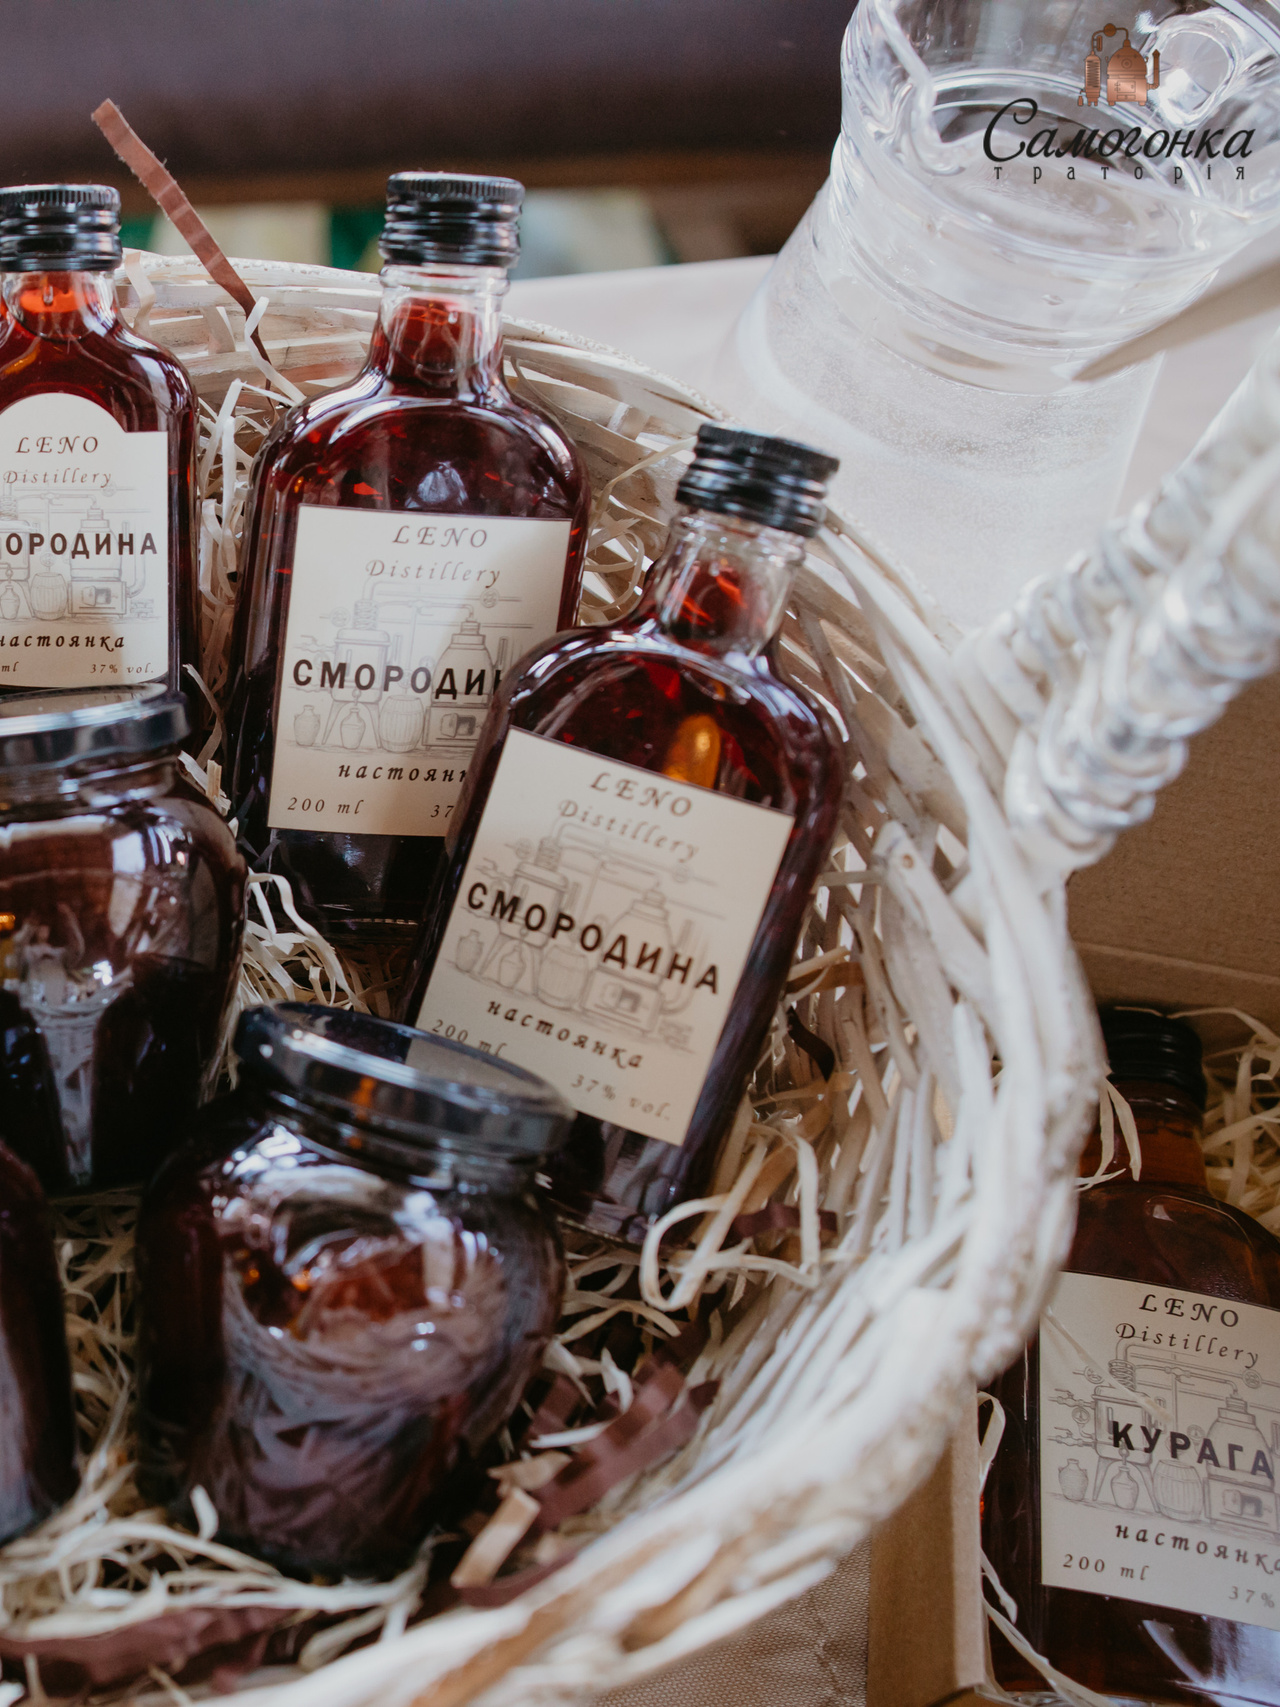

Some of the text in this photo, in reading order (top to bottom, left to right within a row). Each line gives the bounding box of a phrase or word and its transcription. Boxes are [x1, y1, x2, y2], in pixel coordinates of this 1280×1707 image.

[16, 436, 99, 454] LENO
[3, 468, 112, 488] Distillery
[392, 525, 488, 548] LENO
[366, 559, 500, 588] Distillery
[1, 660, 20, 673] ml
[90, 663, 118, 674] 37%
[127, 661, 154, 674] vol.
[293, 658, 503, 700] СМОРОДИ
[338, 763, 467, 783] настоян
[287, 797, 454, 819] 200 ml 37
[590, 772, 692, 816] LENO
[558, 800, 699, 863] Distillery
[467, 882, 720, 994] СМОРОДИНА
[432, 1019, 507, 1057] 200 ml
[487, 1001, 644, 1069] настоянка
[571, 1074, 671, 1120] 37% vol.
[1139, 1293, 1239, 1327] LENO
[1115, 1322, 1259, 1369] Distillery
[1112, 1420, 1275, 1480] КУРАГА
[1063, 1553, 1149, 1581] 200 ml
[1228, 1585, 1275, 1608] 37%
